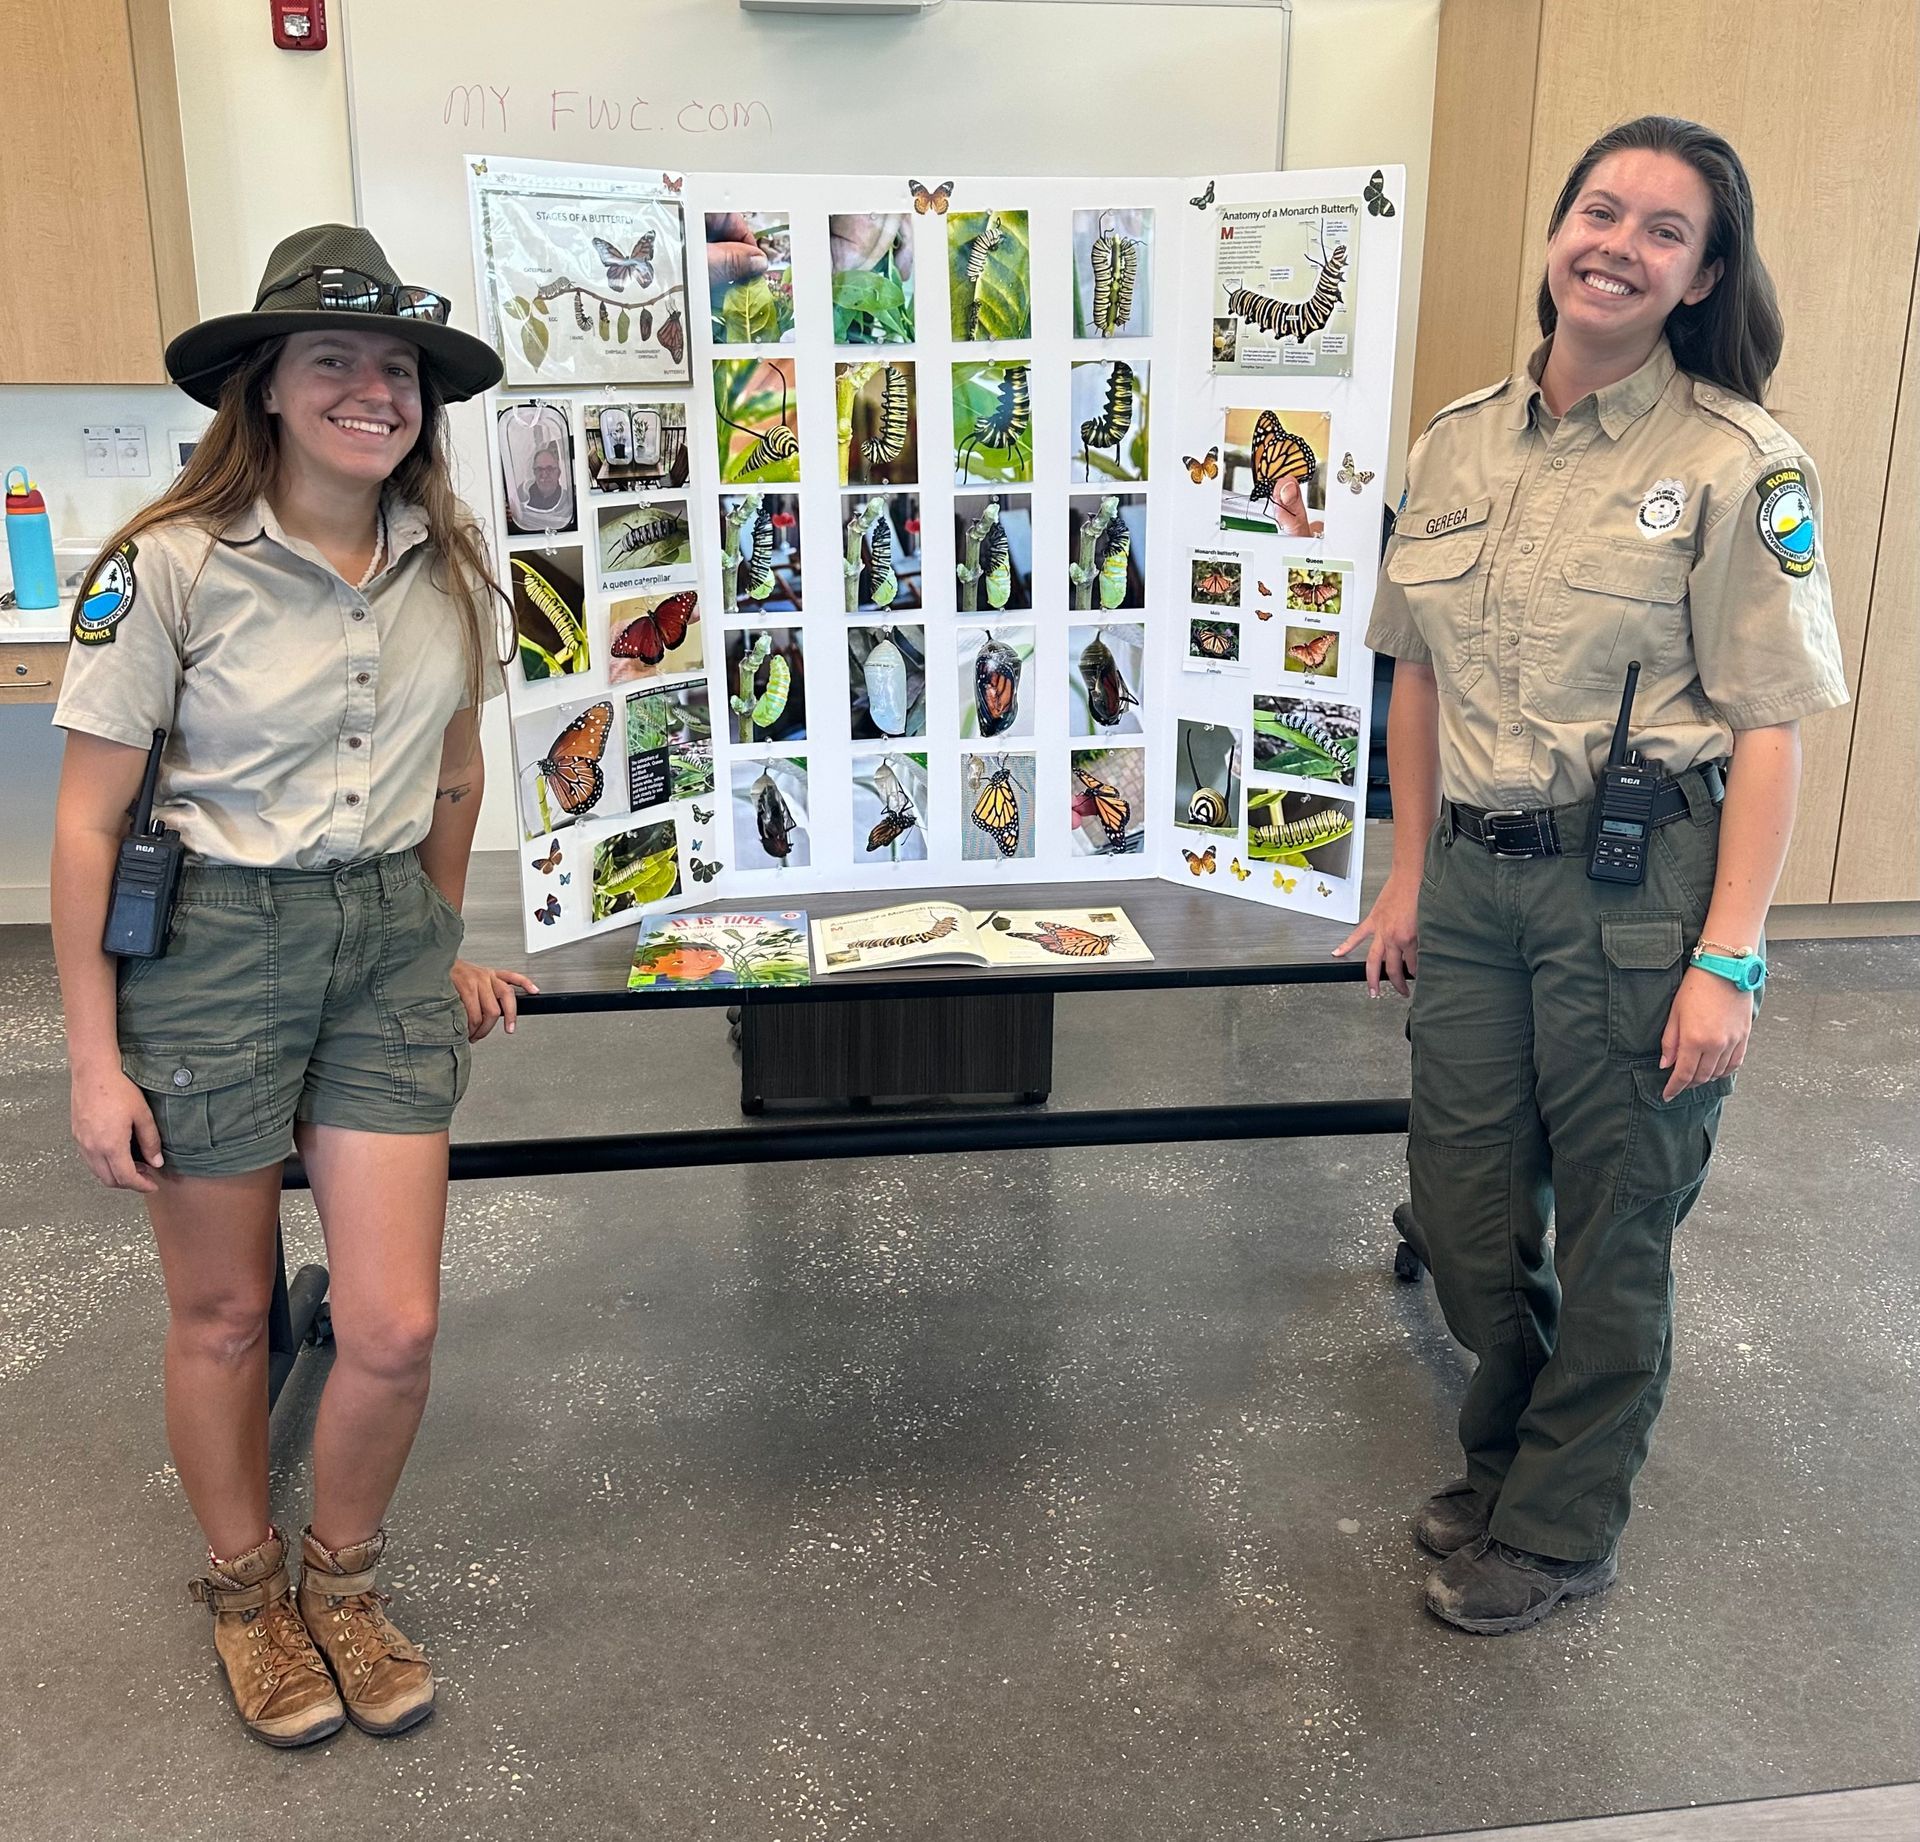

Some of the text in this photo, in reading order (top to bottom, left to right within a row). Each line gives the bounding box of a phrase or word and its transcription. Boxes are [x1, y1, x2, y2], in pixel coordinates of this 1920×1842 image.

[444, 84, 511, 133] MY
[536, 211, 634, 225] STAGES OF A BUTTERFLY
[1222, 203, 1359, 222] Anatomy of a Monarch Butterfly
[1766, 471, 1801, 489] FLORIDA
[1762, 492, 1779, 522] FLORIDA
[1425, 507, 1468, 535] GEREGA
[1785, 560, 1801, 572] PARK
[126, 576, 132, 587] OF
[602, 574, 672, 590] A queen caterpillar
[97, 595, 131, 627] PROTECTION
[84, 628, 111, 640] SERVICE
[1620, 777, 1641, 786] RCA
[135, 844, 155, 853] RCA
[671, 915, 767, 928] IT IS TIME
